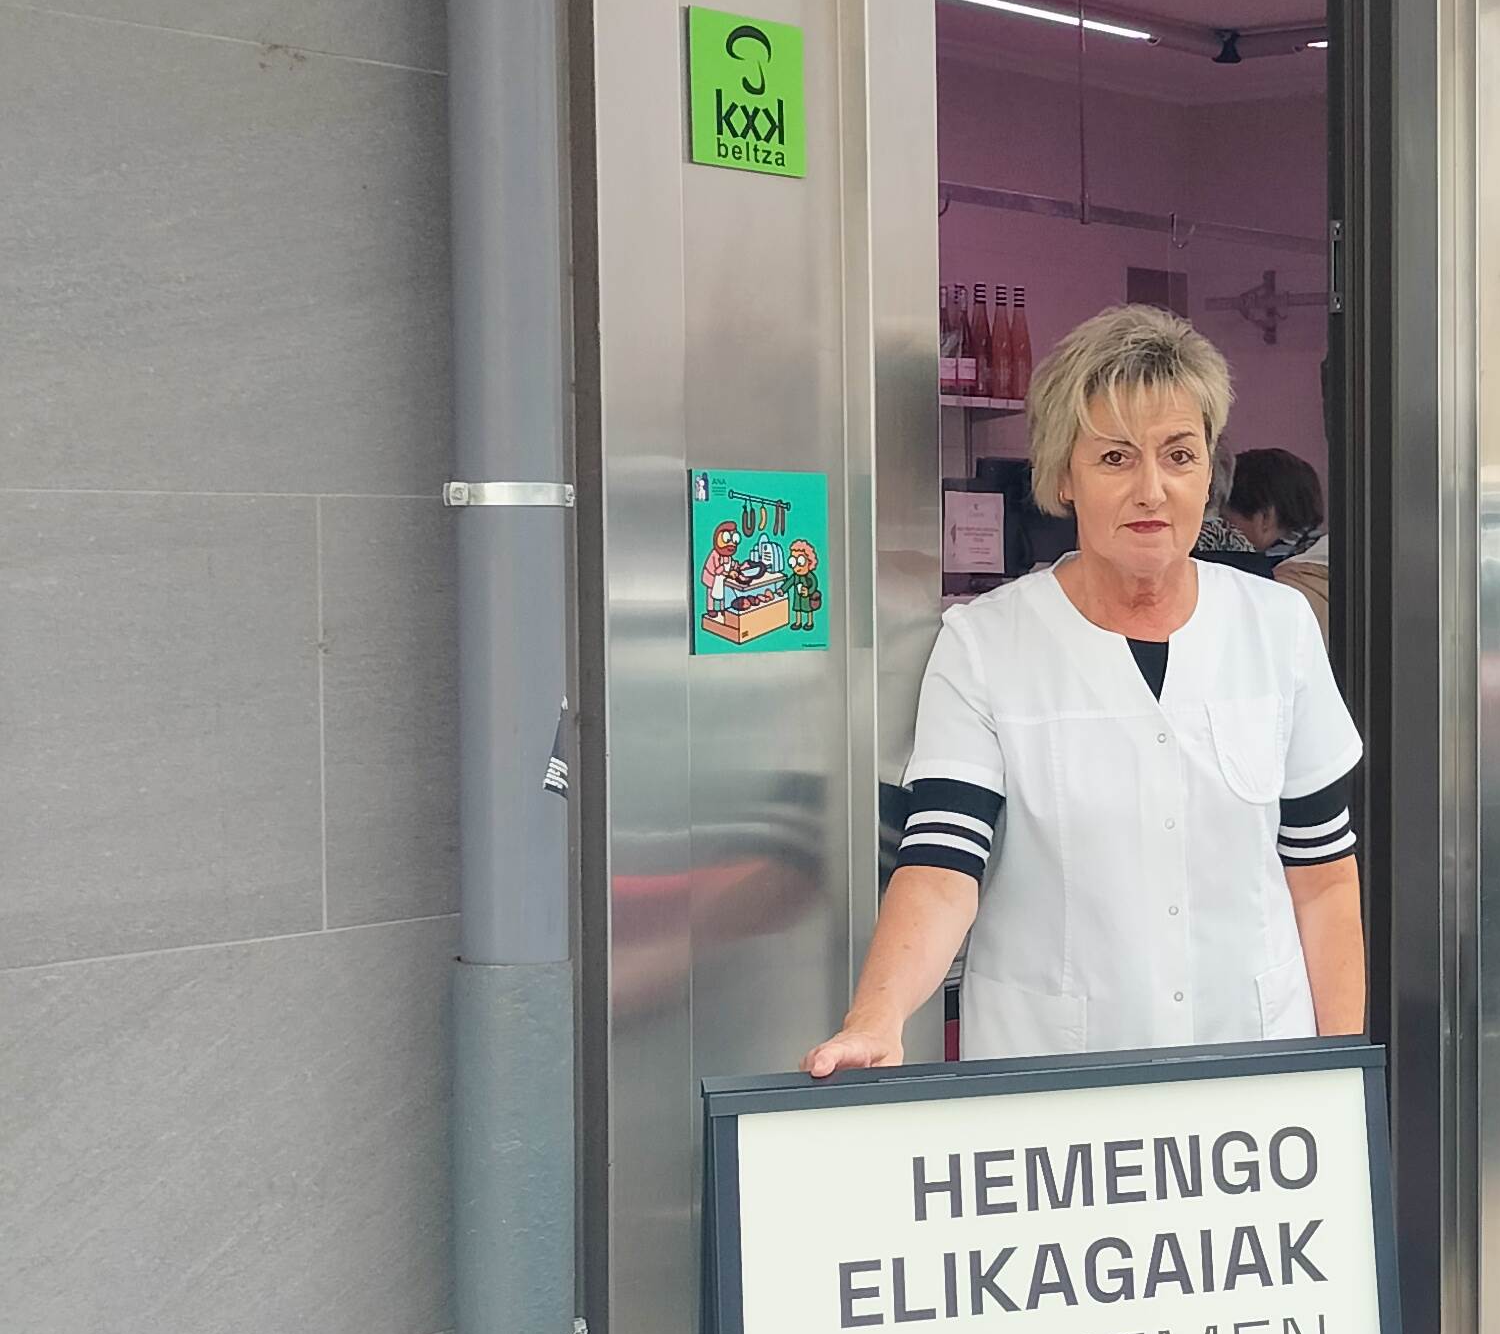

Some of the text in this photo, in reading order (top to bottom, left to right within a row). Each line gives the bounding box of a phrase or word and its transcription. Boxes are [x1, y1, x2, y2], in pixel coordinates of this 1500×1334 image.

[716, 136, 786, 167] beltza
[912, 1126, 1318, 1221] HEMENGO
[838, 1219, 1328, 1329] ELIKAGAIAK
